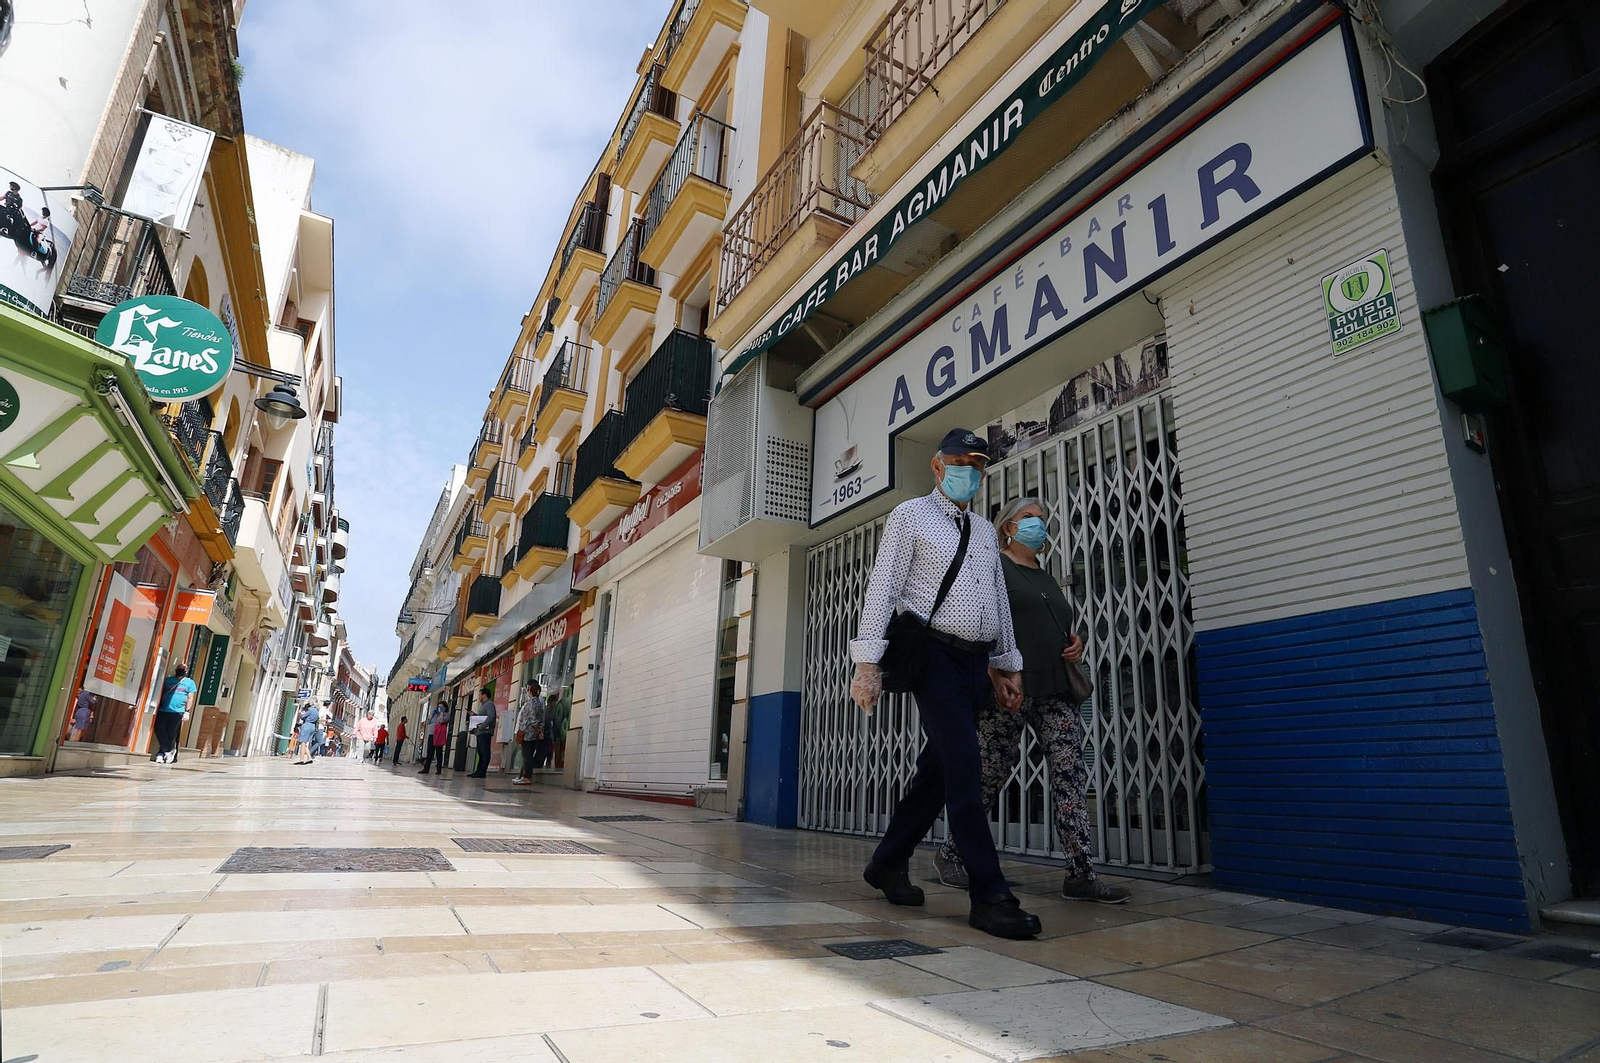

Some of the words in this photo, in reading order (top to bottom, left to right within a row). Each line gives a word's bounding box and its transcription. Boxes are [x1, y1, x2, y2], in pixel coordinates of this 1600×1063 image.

[778, 279, 828, 337] CAFE
[835, 237, 878, 292] BAR
[889, 98, 1024, 244] AGMANIR
[1039, 24, 1110, 97] Centro
[888, 142, 1261, 427] AGMANIR
[1333, 305, 1394, 339] POLICIA
[1336, 297, 1387, 327] AVISO
[182, 326, 222, 343] Tiendas
[1336, 336, 1354, 349] 902
[1357, 328, 1374, 339] 184
[1376, 318, 1395, 331] 902
[172, 386, 189, 394] 1915
[832, 476, 863, 506] 1963
[178, 604, 208, 612] bankinter
[207, 646, 222, 694] Herbolario
